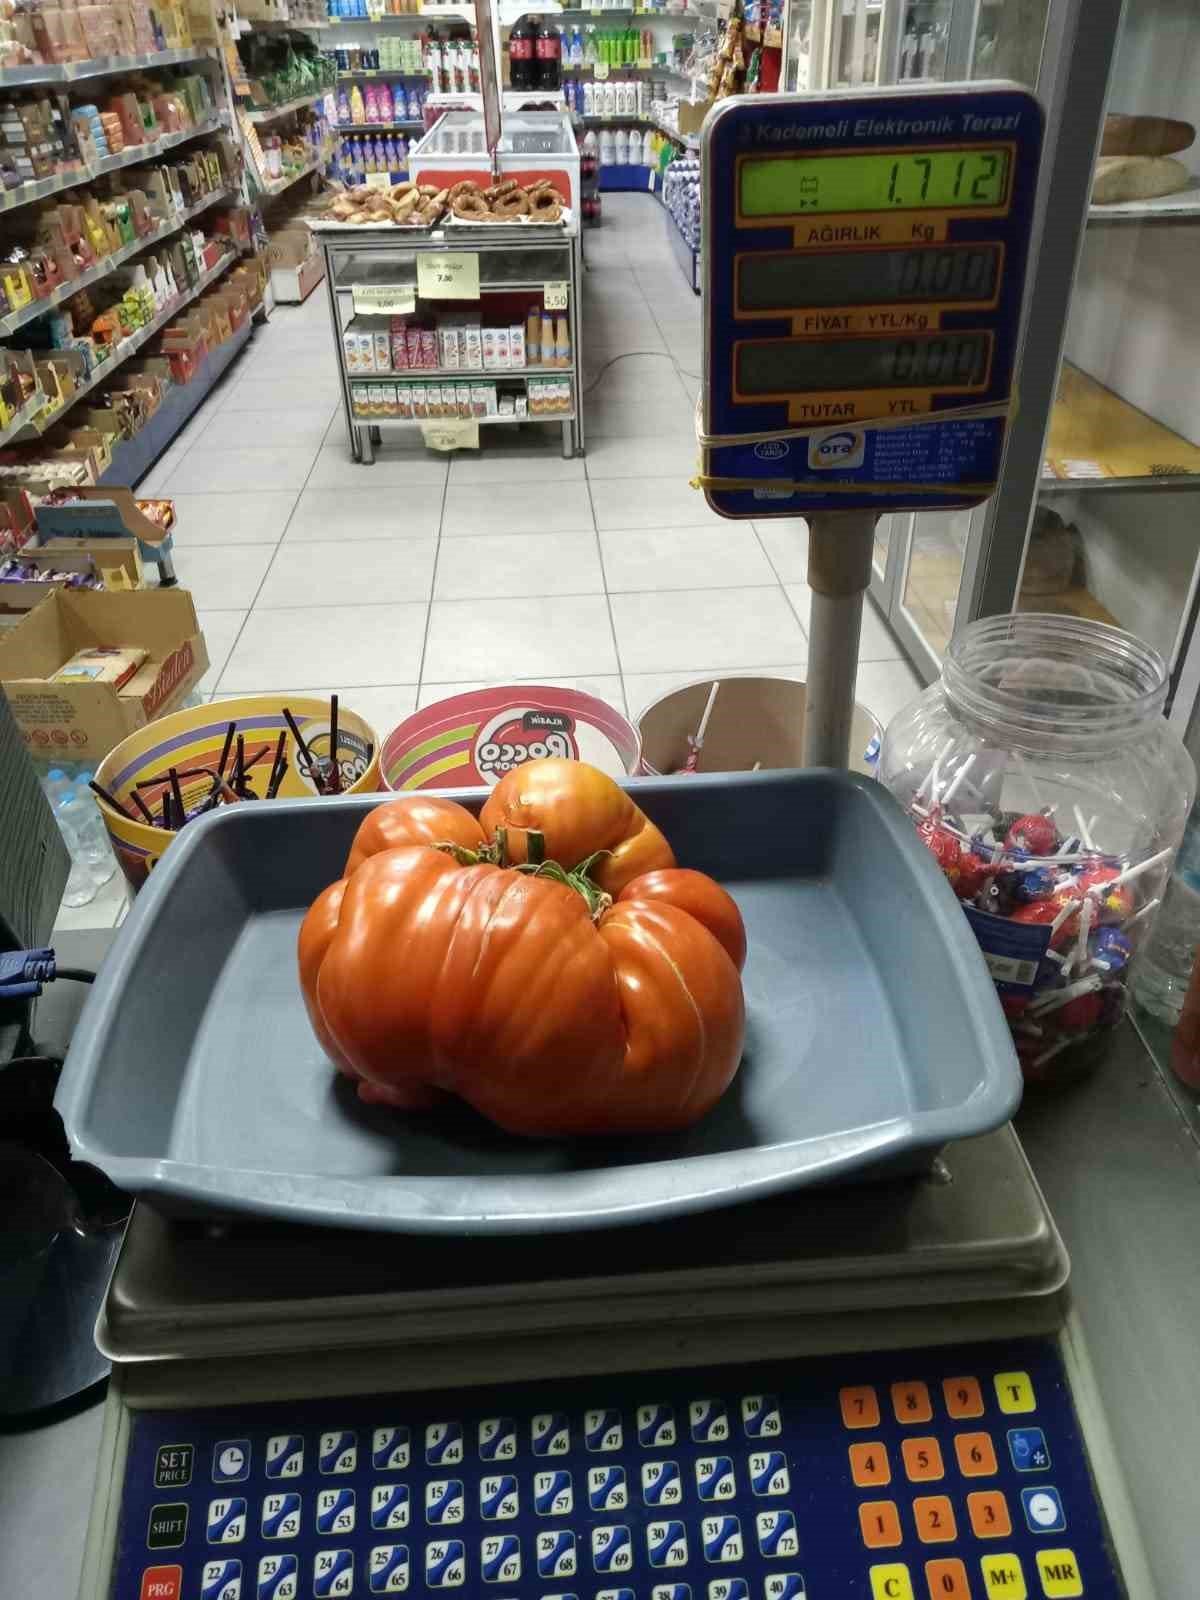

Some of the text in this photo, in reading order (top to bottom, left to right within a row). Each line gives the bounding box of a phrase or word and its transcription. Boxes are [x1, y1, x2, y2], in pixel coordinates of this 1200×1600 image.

[853, 117, 954, 138] Elektronik
[961, 111, 1021, 132] Terazi
[887, 154, 998, 204] 1.712
[911, 223, 935, 241] Kg
[868, 312, 928, 330] YTL/Kg
[801, 402, 919, 418] TUTAR YTL
[958, 1390, 968, 1405] 9
[1007, 1386, 1020, 1401] T
[747, 1401, 758, 1411] 10
[854, 1399, 864, 1415] 7
[907, 1394, 917, 1409] 8
[644, 1411, 650, 1422] 8
[696, 1407, 702, 1418] 9
[538, 1422, 545, 1432] 6
[591, 1416, 598, 1427] 7
[765, 1421, 778, 1431] 50
[433, 1430, 439, 1440] 4
[485, 1425, 492, 1436] 5
[660, 1429, 672, 1440] 48
[712, 1425, 724, 1435] 49
[327, 1438, 333, 1449] 2
[380, 1434, 387, 1445] 3
[553, 1439, 566, 1449] 46
[607, 1434, 619, 1445] 47
[446, 1448, 459, 1459] 44
[500, 1444, 513, 1454] 45
[971, 1447, 981, 1463] 6
[160, 1452, 189, 1469] SET
[340, 1456, 353, 1468] 42
[393, 1452, 406, 1463] 43
[918, 1451, 928, 1467] 5
[286, 1460, 299, 1472] 41
[700, 1463, 713, 1474] 20
[753, 1458, 765, 1470] 21
[865, 1456, 875, 1472] 4
[159, 1470, 187, 1481] PRICE
[593, 1472, 605, 1484] 18
[647, 1468, 659, 1479] 19
[486, 1482, 498, 1494] 16
[539, 1478, 551, 1489] 17
[719, 1483, 732, 1494] 60
[773, 1478, 785, 1489] 61
[378, 1491, 389, 1502] 14
[432, 1487, 443, 1498] 15
[611, 1492, 623, 1504] 58
[665, 1487, 678, 1499] 59
[269, 1500, 281, 1512] 12
[323, 1496, 334, 1508] 13
[502, 1502, 515, 1514] 56
[556, 1497, 568, 1509] 57
[215, 1504, 224, 1516] 11
[448, 1507, 460, 1518] 55
[984, 1506, 995, 1523] 3
[338, 1516, 350, 1528] 53
[393, 1511, 405, 1523] 54
[929, 1512, 941, 1528] 2
[153, 1520, 182, 1533] SHIFT
[283, 1521, 296, 1532] 52
[707, 1523, 718, 1535] 31
[761, 1518, 774, 1530] 32
[228, 1525, 240, 1537] 51
[652, 1529, 664, 1540] 30
[541, 1538, 554, 1550] 28
[598, 1533, 609, 1544] 29
[781, 1538, 794, 1550] 72
[431, 1547, 443, 1559] 26
[486, 1543, 499, 1554] 27
[671, 1549, 684, 1560] 70
[727, 1544, 738, 1555] 71
[320, 1557, 332, 1569] 24
[376, 1552, 388, 1564] 25
[615, 1553, 628, 1565] 69
[263, 1562, 276, 1574] 23
[503, 1564, 517, 1576] 67
[560, 1559, 573, 1570] 68
[208, 1567, 221, 1579] 22
[448, 1568, 461, 1580] 66
[990, 1569, 1016, 1585] M+
[1044, 1564, 1075, 1580] MR
[336, 1578, 349, 1590] 64
[392, 1573, 405, 1585] 65
[943, 1574, 954, 1592] 0
[148, 1583, 174, 1596] PRG
[279, 1583, 292, 1595] 63
[713, 1586, 726, 1598] 39
[770, 1581, 783, 1593] 40
[884, 1579, 899, 1597] C
[223, 1588, 236, 1600] 62
